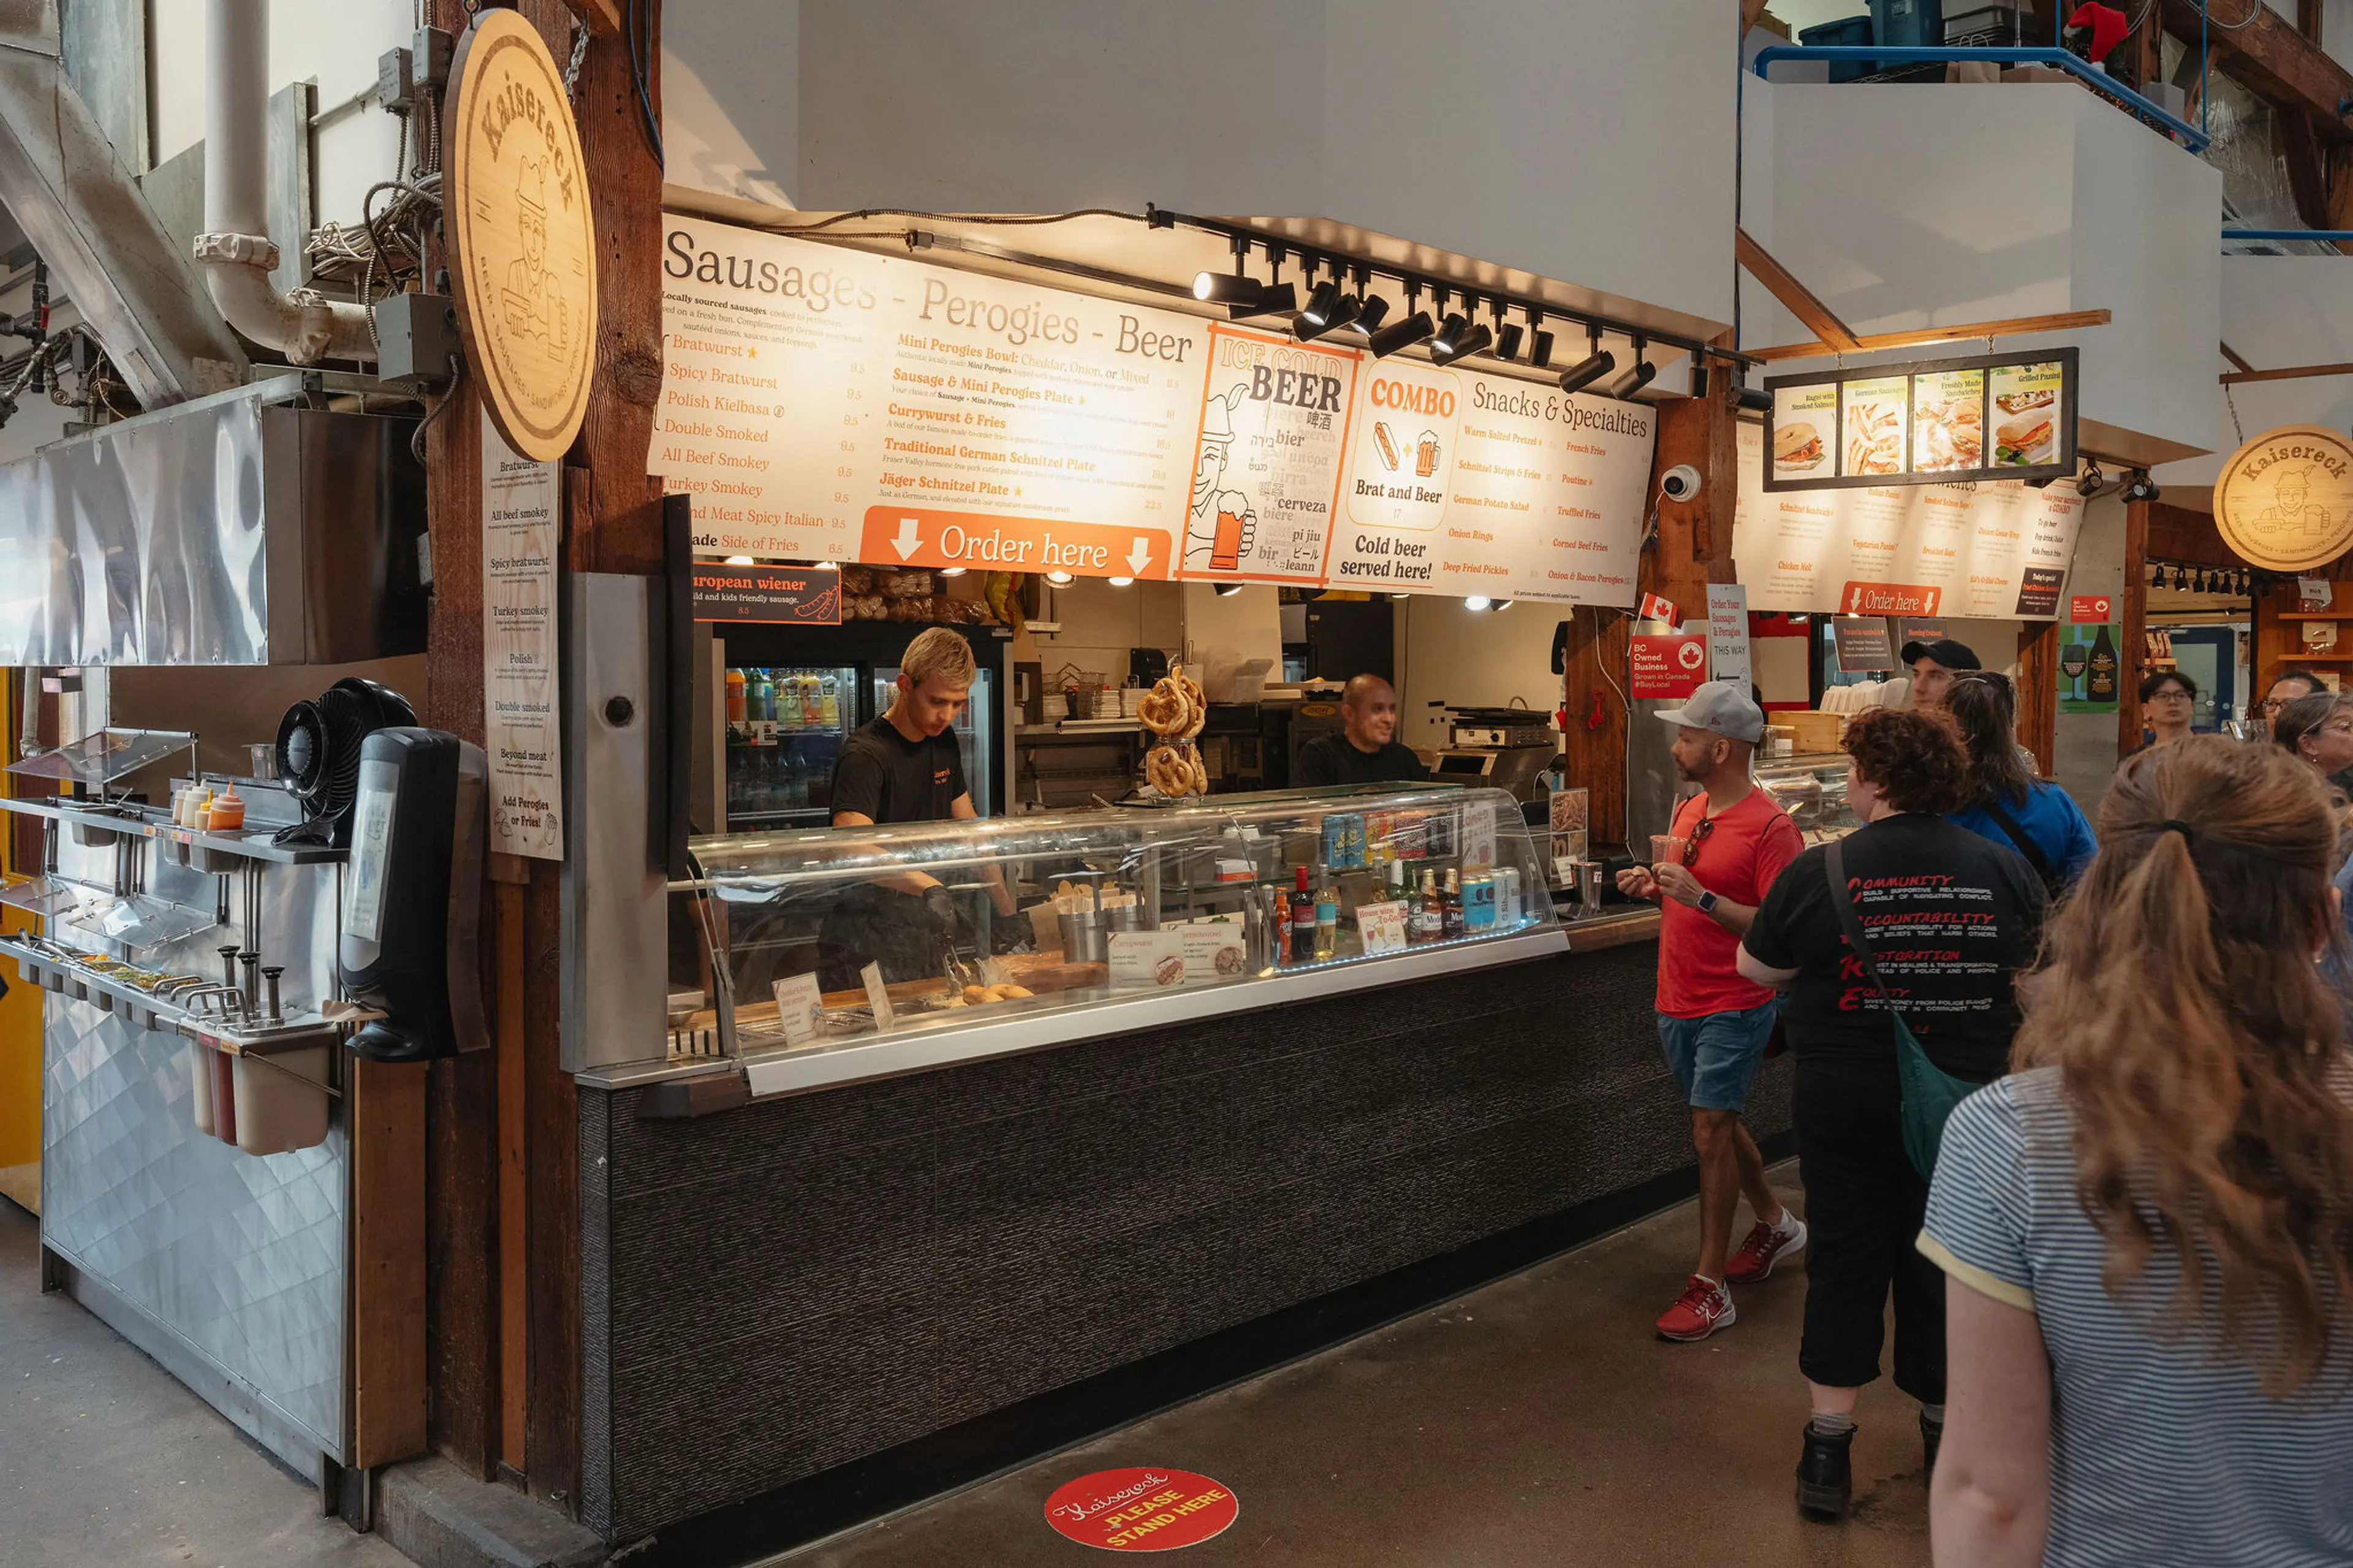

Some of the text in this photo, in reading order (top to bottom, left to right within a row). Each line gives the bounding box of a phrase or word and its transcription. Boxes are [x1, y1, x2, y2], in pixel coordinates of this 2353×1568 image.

[481, 69, 574, 213] Kaisereck
[664, 230, 1193, 363] Sausages Perogies Beer
[694, 297, 728, 309] sourced
[696, 310, 716, 320] fresh
[673, 335, 744, 357] Bratwurst
[896, 333, 928, 349] Mini
[930, 339, 982, 360] Perogies
[985, 347, 1019, 363] Bowl:
[1106, 369, 1118, 379] or
[1120, 369, 1150, 384] Mixed
[968, 360, 982, 369] Mini
[1221, 338, 1343, 381] ICE COLD
[670, 363, 779, 389] Spicy Bratwurst
[2018, 371, 2061, 383] Grilled Panini
[893, 368, 1074, 404] Sausage & Mini Perogies Plate
[1249, 365, 1343, 413] BEER
[1945, 388, 1982, 398] Sandwiches
[667, 390, 770, 416] Polish Kielbasa
[938, 392, 987, 404] Sausage Mini
[1370, 378, 1456, 418] COMBO
[889, 403, 960, 423] Currywurst
[964, 413, 975, 425] &
[977, 414, 1006, 429] Fries
[1472, 382, 1648, 437] Snacks & Specialties
[1306, 411, 1332, 431] 啤酒
[664, 419, 770, 443] Double Smoked
[1275, 429, 1305, 446] bier
[1464, 426, 1487, 439] Warm
[1512, 433, 1537, 446] Pretzel
[884, 436, 956, 457] Traditional
[960, 446, 1007, 462] German
[1010, 452, 1062, 469] Schnitzel
[1067, 458, 1096, 471] Plate
[1566, 442, 1606, 456] French Fries
[501, 461, 539, 472] Bratwurst
[662, 447, 770, 472] All Beef Smokey
[2241, 445, 2348, 483] Kaisereck
[662, 475, 763, 498] Turkey Smokey
[880, 472, 916, 488] Jäger
[919, 476, 976, 493] Schnitzel
[979, 482, 1010, 495] Plate
[1561, 474, 1588, 486] Poutine
[1355, 479, 1442, 503] Brat and Beer
[1277, 498, 1327, 513] cerveza
[1453, 494, 1530, 511] German Potato Salad
[491, 507, 549, 521] All beef smokey
[710, 507, 743, 522] Meat
[747, 509, 781, 527] Spicy
[784, 512, 825, 528] Italian
[1557, 506, 1602, 520] Truffled Fries
[1292, 529, 1321, 543] pi jiu
[1449, 527, 1494, 542] Onion Rings
[721, 536, 749, 548] Side
[752, 536, 767, 549] of
[768, 539, 800, 551] Fries
[939, 524, 1108, 569] Order here
[1355, 535, 1427, 558] Cold beer
[1577, 540, 1592, 551] Beef
[1592, 542, 1608, 552] Fries
[1258, 545, 1279, 560] bir
[1293, 547, 1319, 561] ビール
[490, 556, 549, 570] Spicy bratwurst
[1286, 560, 1316, 572] leann
[1340, 560, 1433, 580] served here!
[1443, 561, 1509, 576] Deep Fried Pickles
[1548, 570, 1569, 580] Onion
[1577, 572, 1596, 582] Bacon
[757, 577, 807, 592] wiener
[704, 593, 720, 602] and
[721, 593, 738, 602] kids
[739, 594, 768, 604] friendly
[1865, 590, 1919, 612] Order here
[493, 605, 549, 619] Turkey smokey
[1634, 644, 1647, 653] BC
[1714, 645, 1747, 656] THIS WAY
[509, 653, 533, 665] Polish
[1634, 653, 1662, 662] Owned
[1634, 662, 1669, 672] Business
[495, 701, 550, 713] Double smoked
[501, 748, 547, 762] Beyond meat
[502, 795, 550, 811] Add Perogies
[511, 815, 542, 828] or Fries!
[1052, 1472, 1169, 1521] Kaisereck
[1104, 1490, 1186, 1527] PLEASE
[1106, 1488, 1229, 1547] STAND HERE
